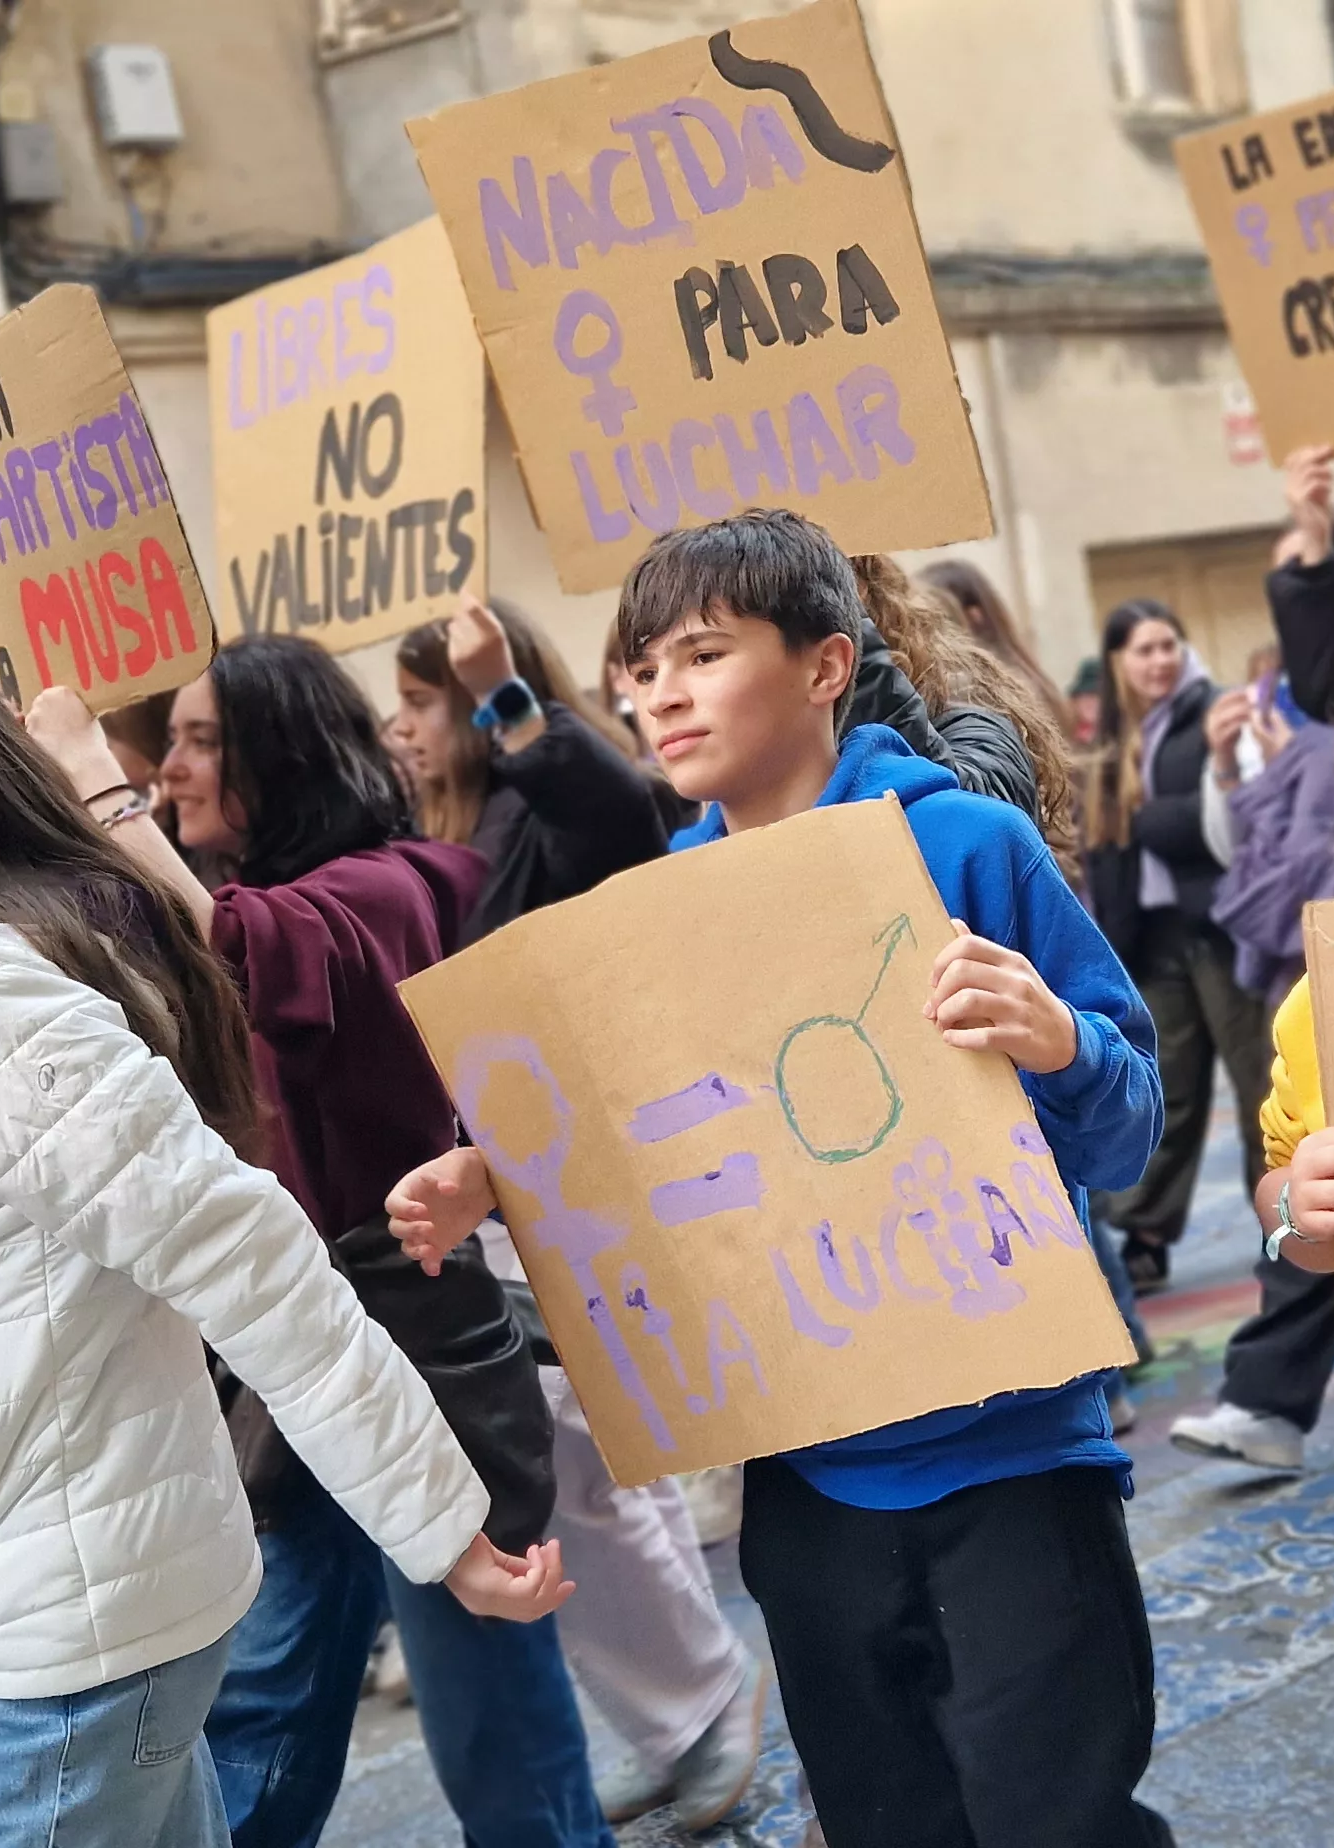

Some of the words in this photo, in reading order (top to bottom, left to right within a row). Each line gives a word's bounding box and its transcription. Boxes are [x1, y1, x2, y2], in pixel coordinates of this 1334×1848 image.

[477, 96, 808, 292] NACIDA
[1219, 132, 1275, 190] LA
[673, 243, 901, 382] PARA
[313, 390, 405, 505] NO
[568, 363, 916, 543] LUCHAR
[19, 536, 198, 692] MUSA
